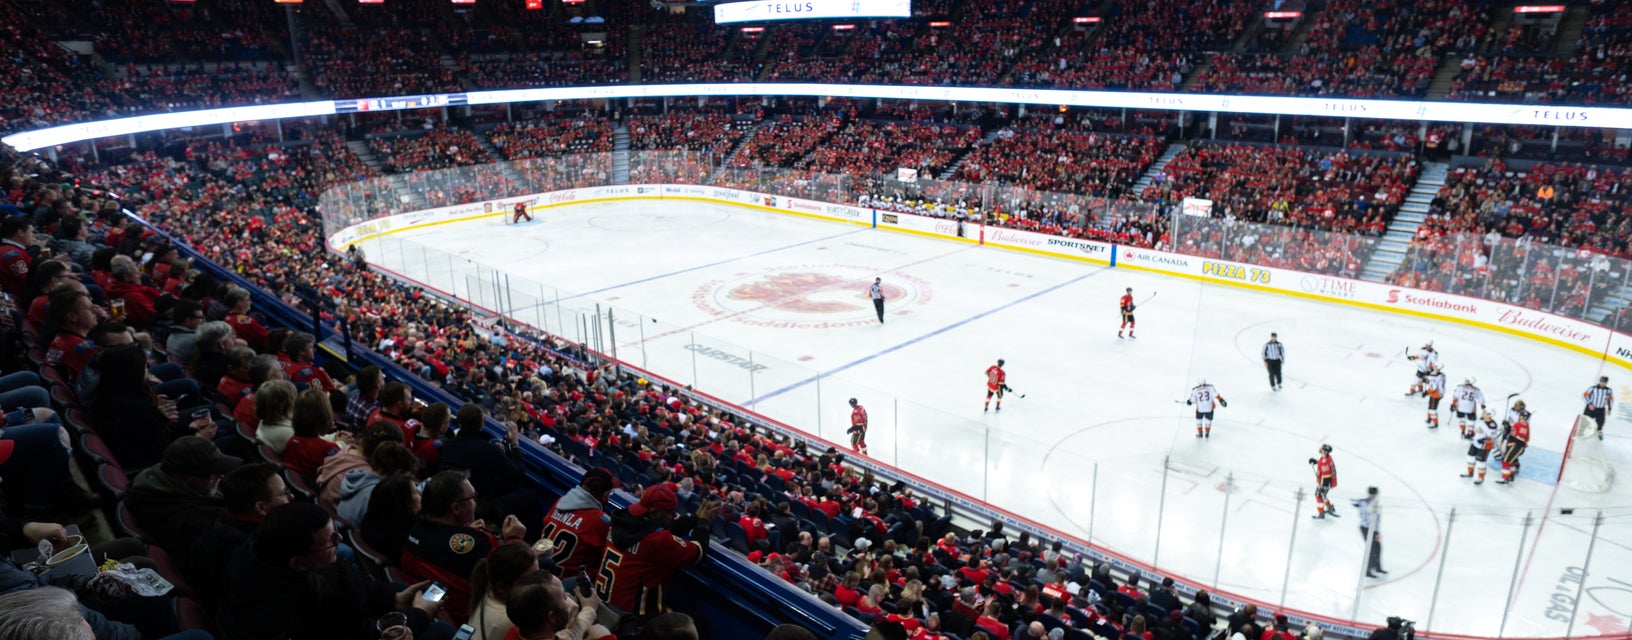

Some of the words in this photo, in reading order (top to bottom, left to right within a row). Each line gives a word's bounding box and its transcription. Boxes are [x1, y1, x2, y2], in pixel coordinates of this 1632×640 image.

[767, 2, 813, 13] TELUS
[1150, 96, 1183, 105] TELUS
[1325, 102, 1367, 112] TELUS
[1534, 110, 1588, 121] TELUS
[549, 191, 576, 202] Coca-Cola
[990, 230, 1043, 247] Budweiser
[1047, 238, 1105, 253] SPORTSNET
[1137, 253, 1150, 261] AIR
[1151, 255, 1188, 267] CANADA
[1202, 261, 1246, 280] PIZZA
[1250, 268, 1271, 284] 73
[1320, 277, 1357, 293] TIME
[1404, 294, 1478, 314] Scotiabank
[1498, 306, 1592, 342] Budweiser
[682, 343, 768, 374] CARSTAR
[1197, 391, 1210, 402] 23
[1461, 390, 1475, 402] 26
[595, 546, 624, 604] 5
